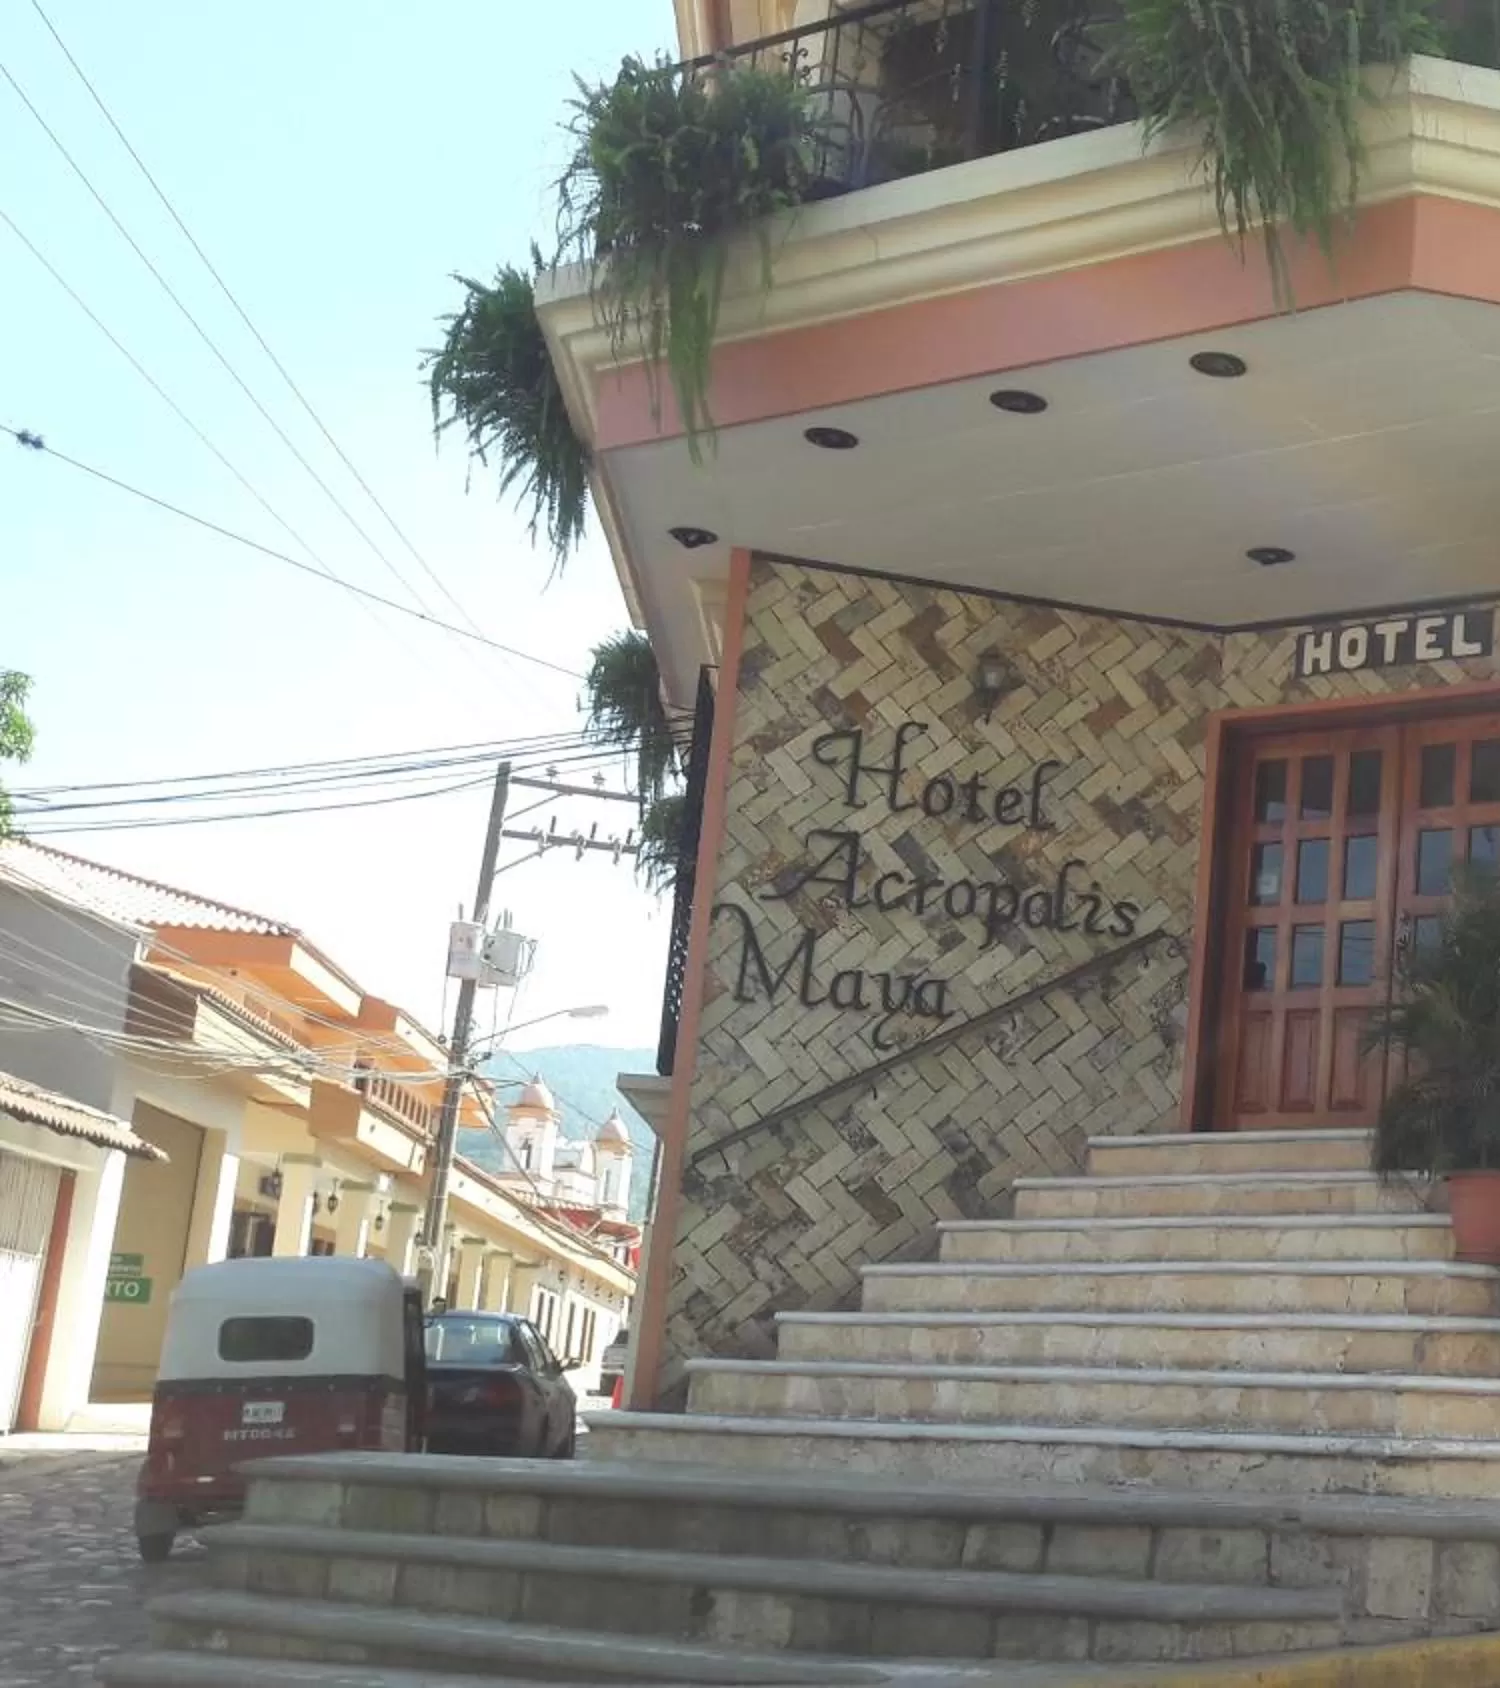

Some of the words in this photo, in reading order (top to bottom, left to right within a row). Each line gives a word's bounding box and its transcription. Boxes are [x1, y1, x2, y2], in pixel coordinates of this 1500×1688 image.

[1302, 613, 1482, 676] HOTEL
[811, 721, 1062, 831] Hotel
[759, 828, 1142, 950] Acropolis
[712, 903, 954, 1051] Maya
